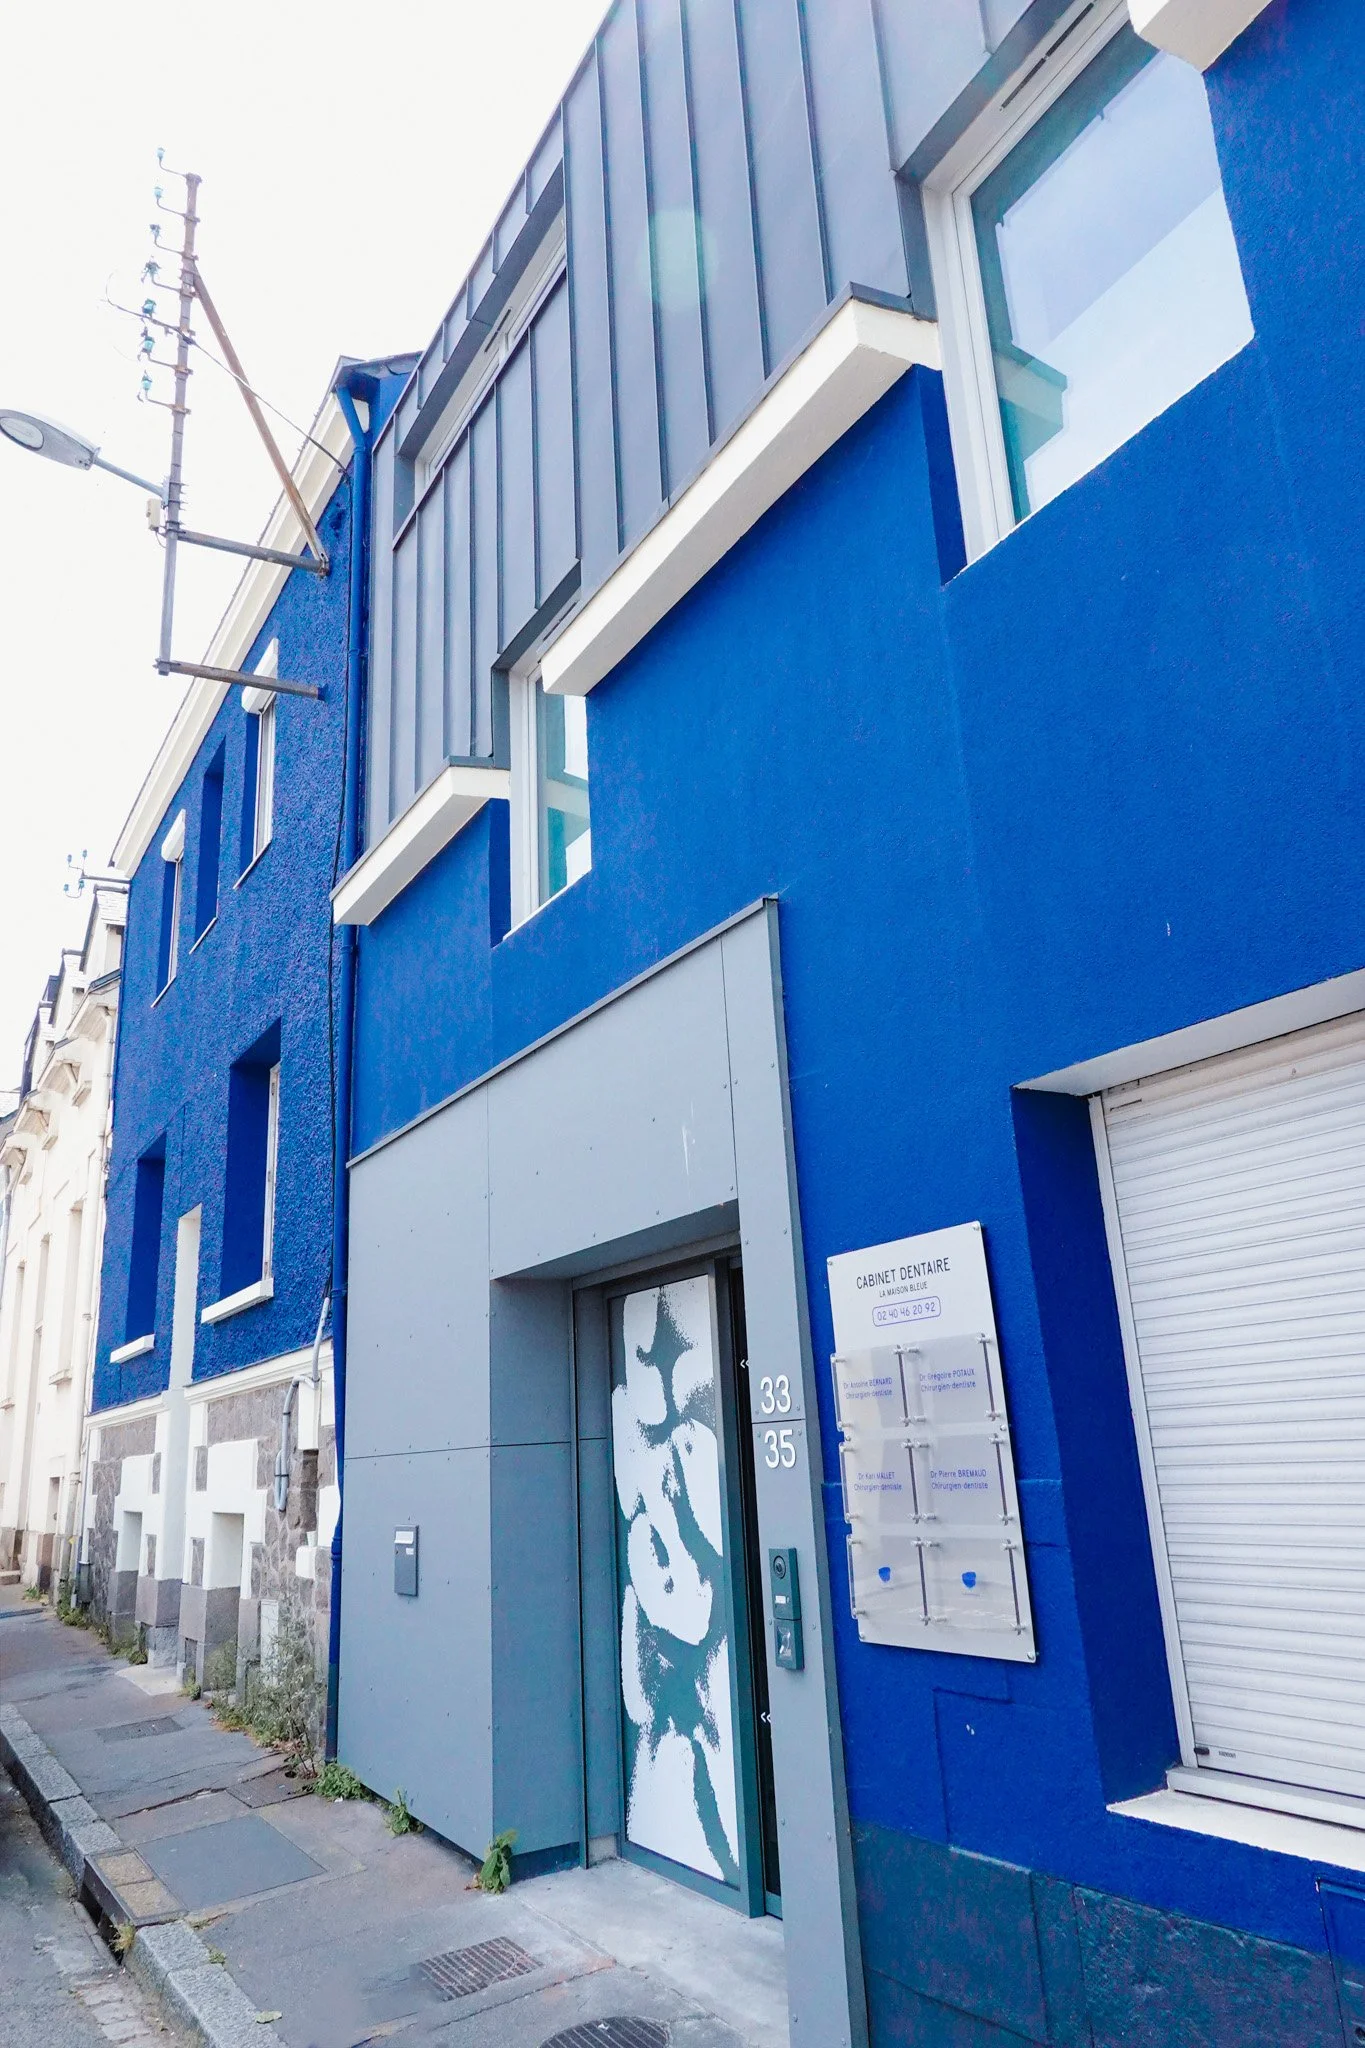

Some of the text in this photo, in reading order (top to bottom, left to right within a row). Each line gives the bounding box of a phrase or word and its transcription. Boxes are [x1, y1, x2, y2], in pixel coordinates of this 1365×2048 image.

[856, 1257, 951, 1290] CABINET DENTAIRE
[887, 1286, 908, 1296] MAISON
[910, 1281, 928, 1292] BLEUE
[877, 1302, 936, 1322] 02 40 46 20 92
[952, 1368, 975, 1378] POTAUX
[760, 1374, 792, 1414] 33
[764, 1429, 796, 1468] 35
[938, 1470, 956, 1478] Pierre
